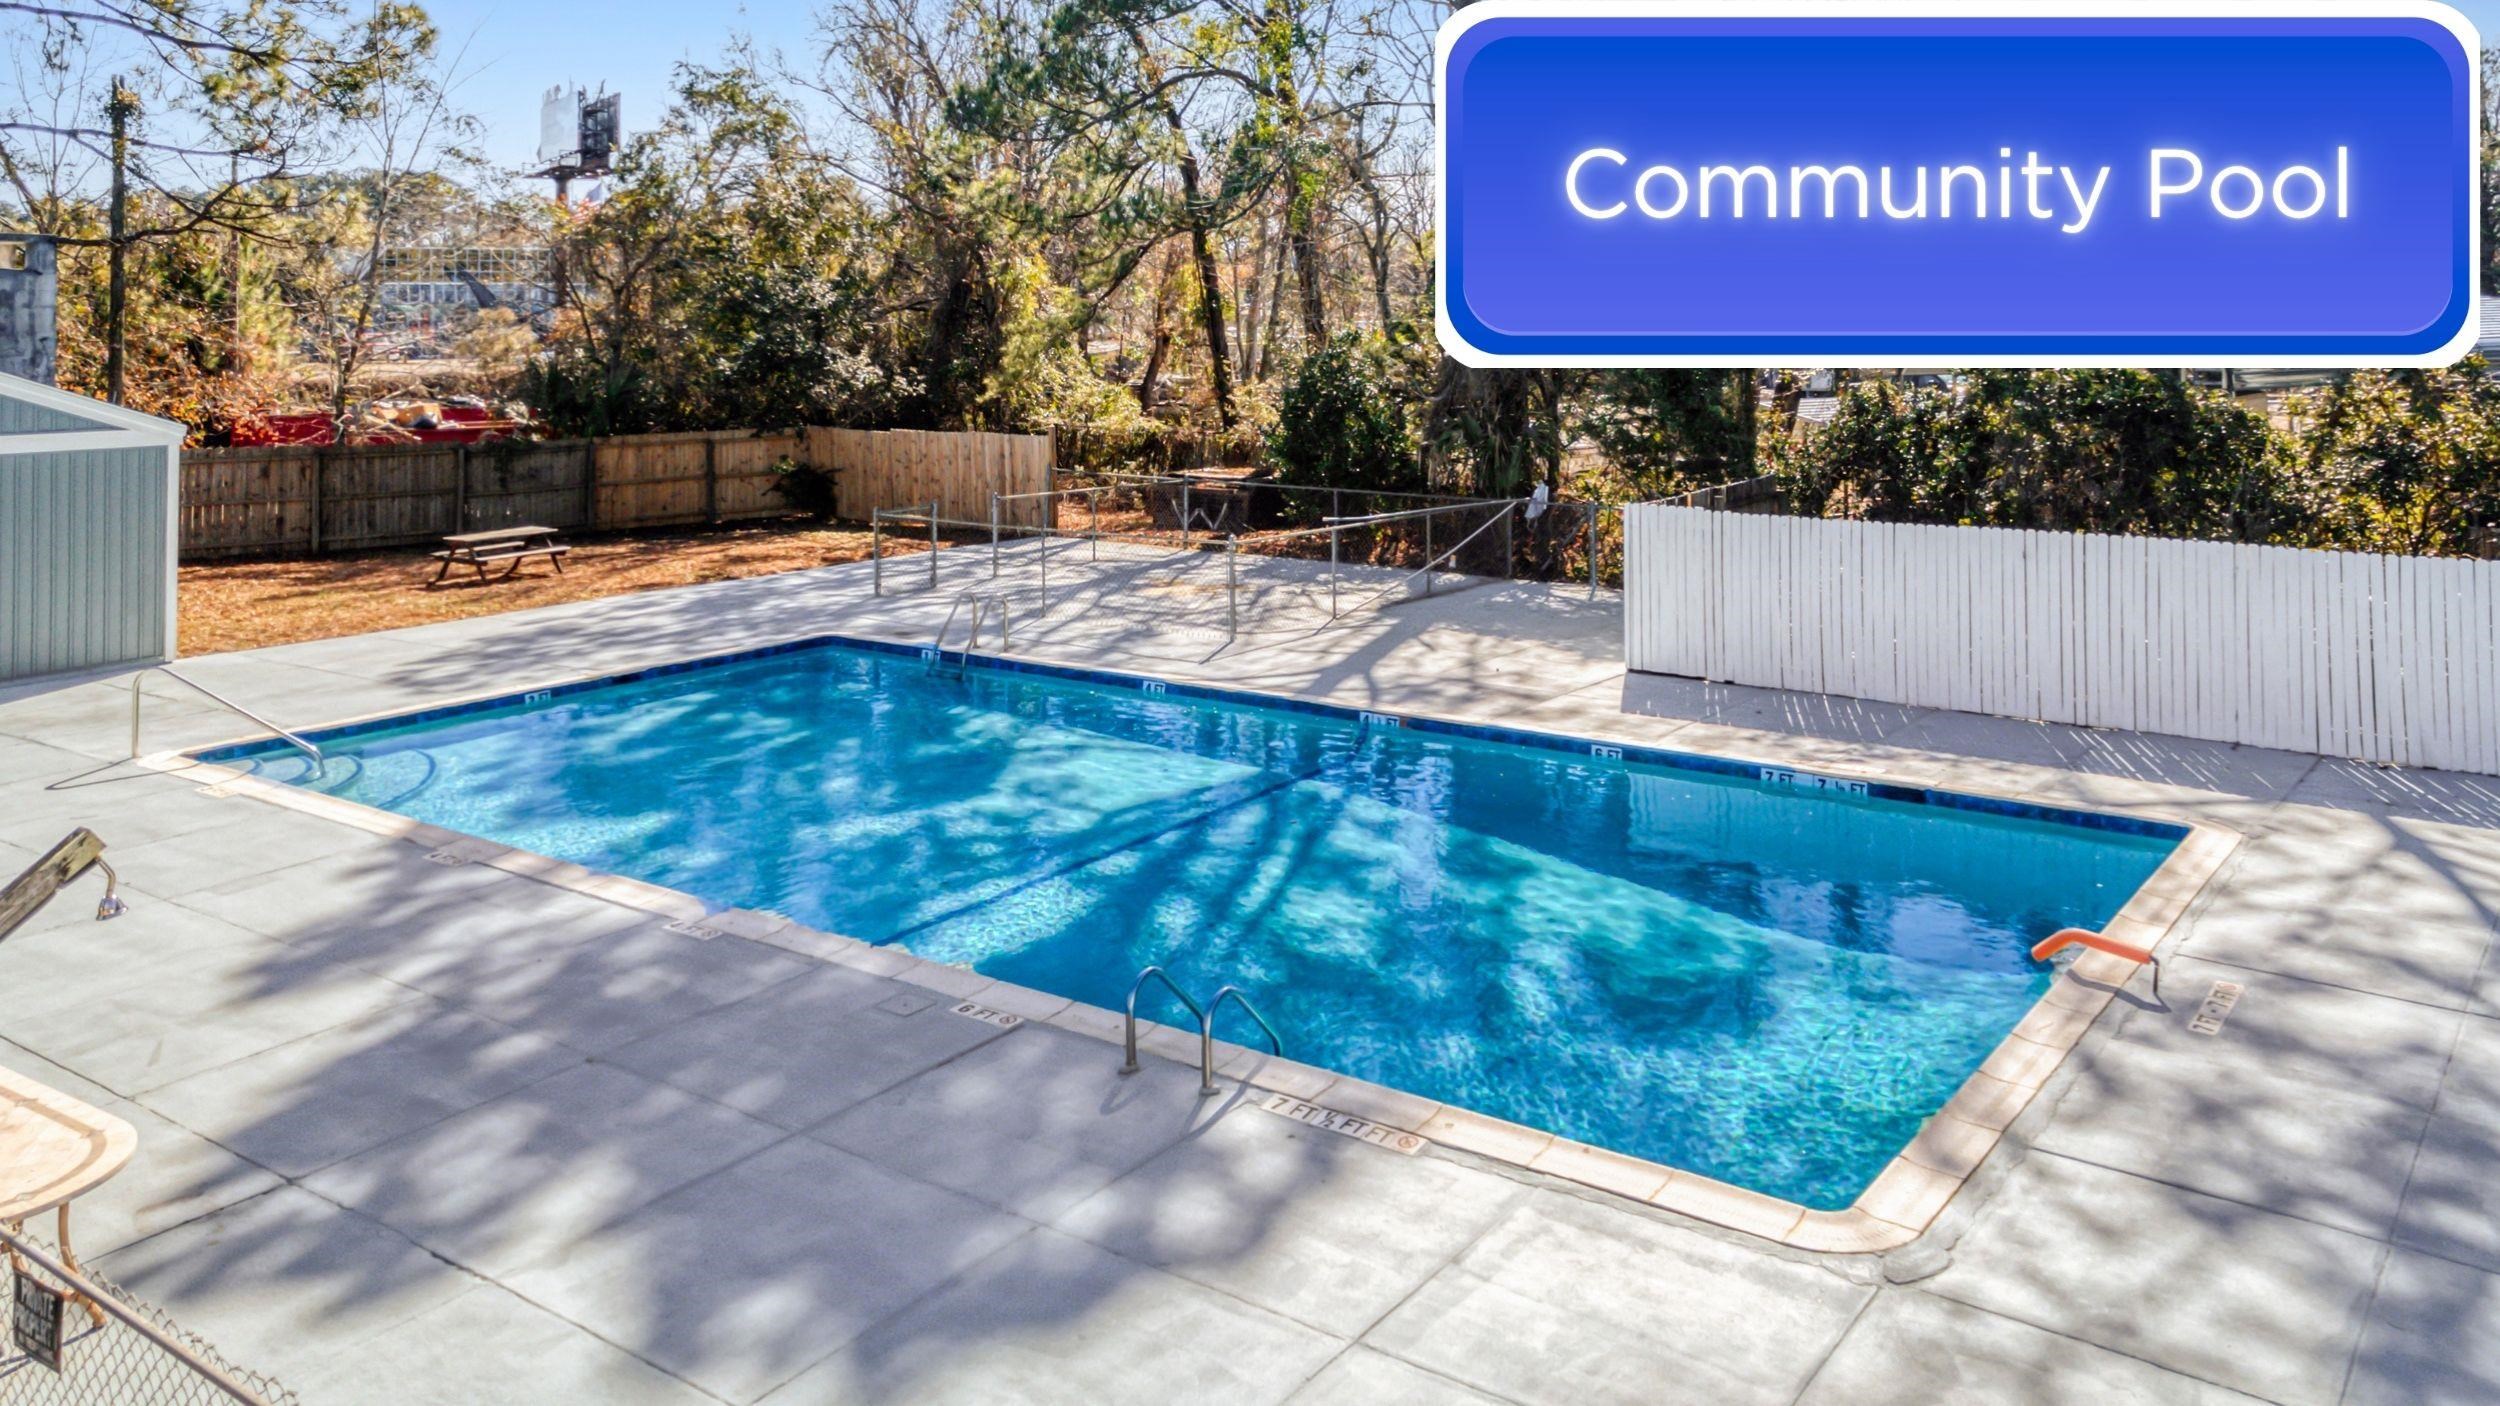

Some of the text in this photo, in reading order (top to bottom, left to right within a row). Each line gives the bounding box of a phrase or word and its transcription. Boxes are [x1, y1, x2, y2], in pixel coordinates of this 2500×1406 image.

[1607, 749, 1621, 760] FT
[1765, 771, 1794, 784] 7 FT
[1818, 778, 1827, 790] 7
[1850, 783, 1865, 793] FT
[957, 1004, 1000, 1020] 6 FT
[1271, 1097, 1288, 1110] 7
[1289, 1103, 1319, 1120] FT
[1338, 1118, 1370, 1134] FT
[1364, 1126, 1396, 1143] FT
